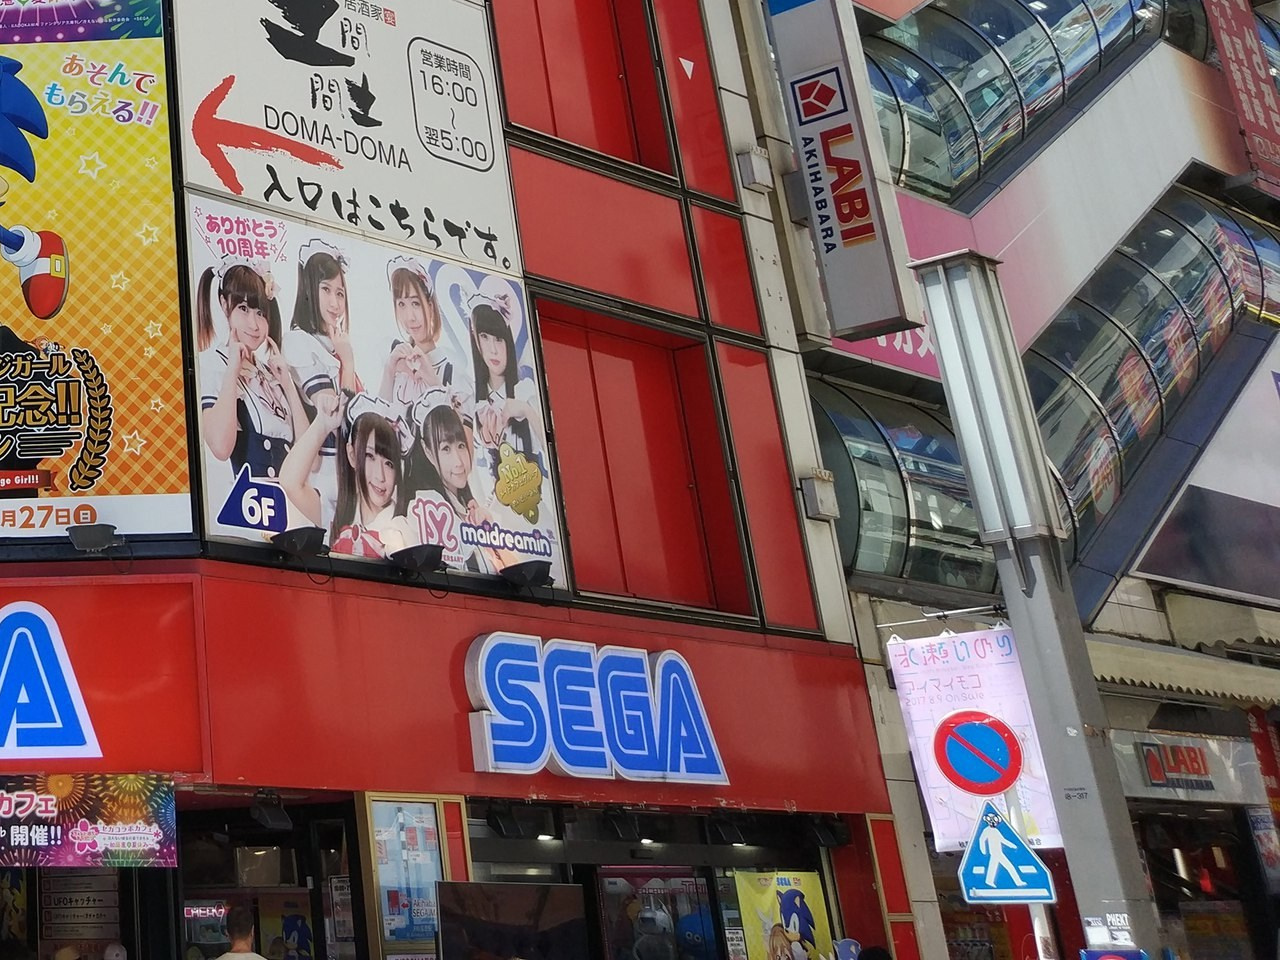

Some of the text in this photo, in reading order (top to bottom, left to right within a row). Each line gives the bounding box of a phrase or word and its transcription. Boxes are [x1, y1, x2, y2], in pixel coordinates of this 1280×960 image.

[60, 53, 157, 95] あそんで
[420, 49, 471, 81] 営業時間
[44, 81, 161, 127] もらえる!!
[419, 70, 478, 108] 16:00
[264, 105, 412, 172] DOMA-DOMA
[424, 126, 487, 162] 翌5:00
[802, 135, 837, 254] AKIHABARA
[820, 123, 877, 248] LABI
[206, 214, 277, 239] ありがとう
[216, 238, 271, 259] 10周年
[241, 488, 275, 528] 6F
[461, 524, 551, 556] maidreamin
[900, 674, 982, 696] アイマイモコ
[480, 634, 726, 782] SEGA
[1163, 744, 1210, 775] LABI
[10, 825, 61, 846] 開催!!
[776, 876, 792, 887] SEGA
[54, 897, 103, 906] UFOキャッチャー
